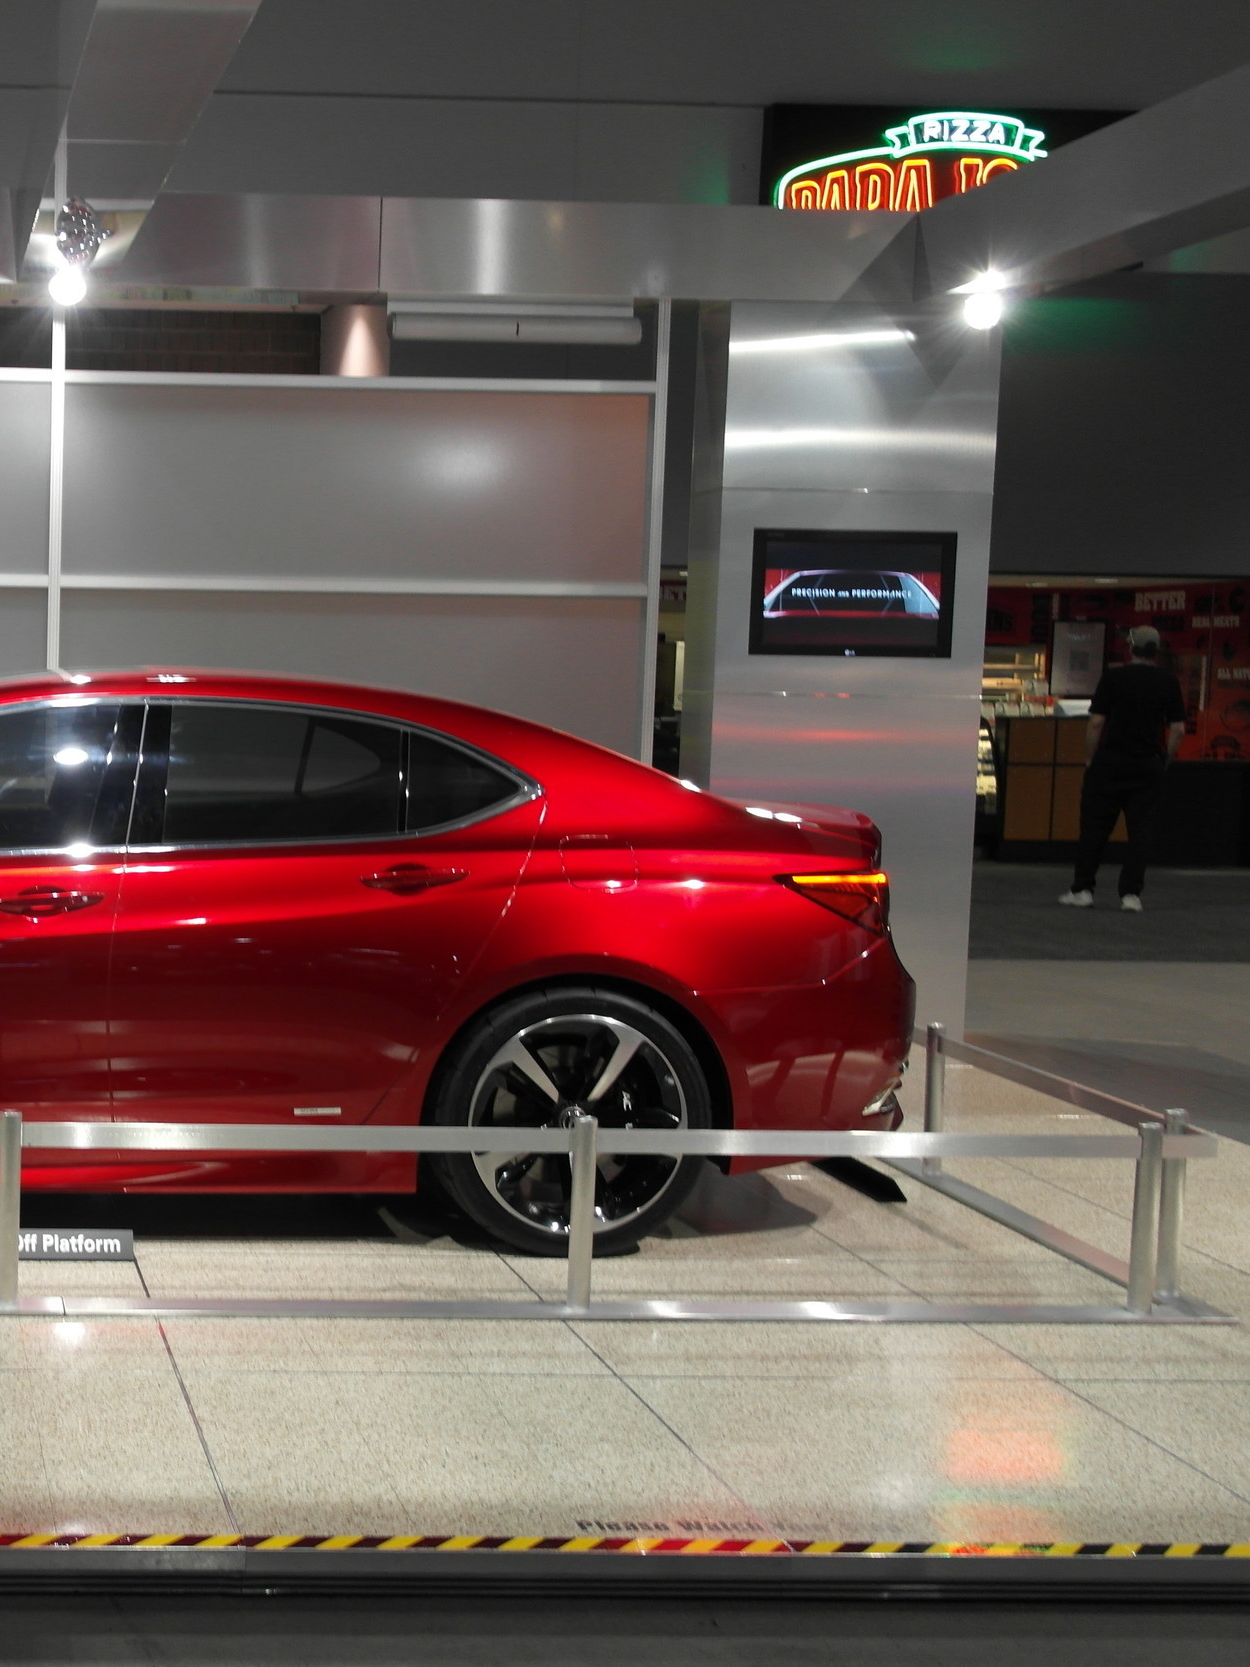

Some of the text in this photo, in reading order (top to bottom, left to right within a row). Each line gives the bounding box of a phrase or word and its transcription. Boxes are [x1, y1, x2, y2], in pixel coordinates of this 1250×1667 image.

[791, 587, 835, 597] PRECISION
[852, 588, 912, 599] PERFORMANCE
[1134, 590, 1186, 612] BETTER
[42, 1233, 121, 1254] Platform
[576, 1518, 670, 1533] Please
